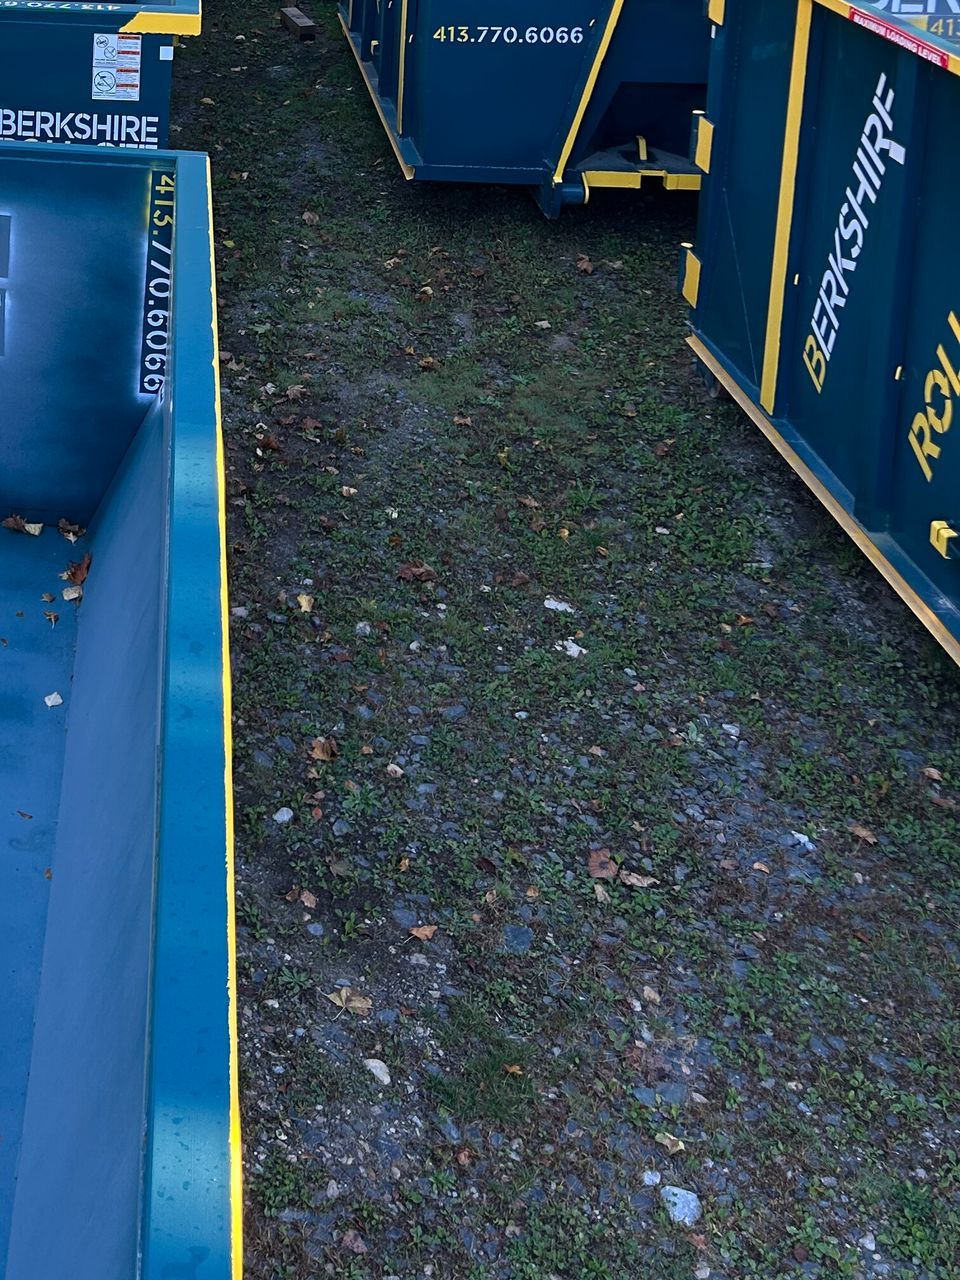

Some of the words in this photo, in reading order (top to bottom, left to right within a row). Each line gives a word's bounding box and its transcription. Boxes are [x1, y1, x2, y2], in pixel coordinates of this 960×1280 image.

[433, 26, 584, 44] 413.770.6066
[853, 14, 886, 37] MAXIMUM
[886, 28, 918, 54] LOADING
[917, 45, 942, 66] LEVEL
